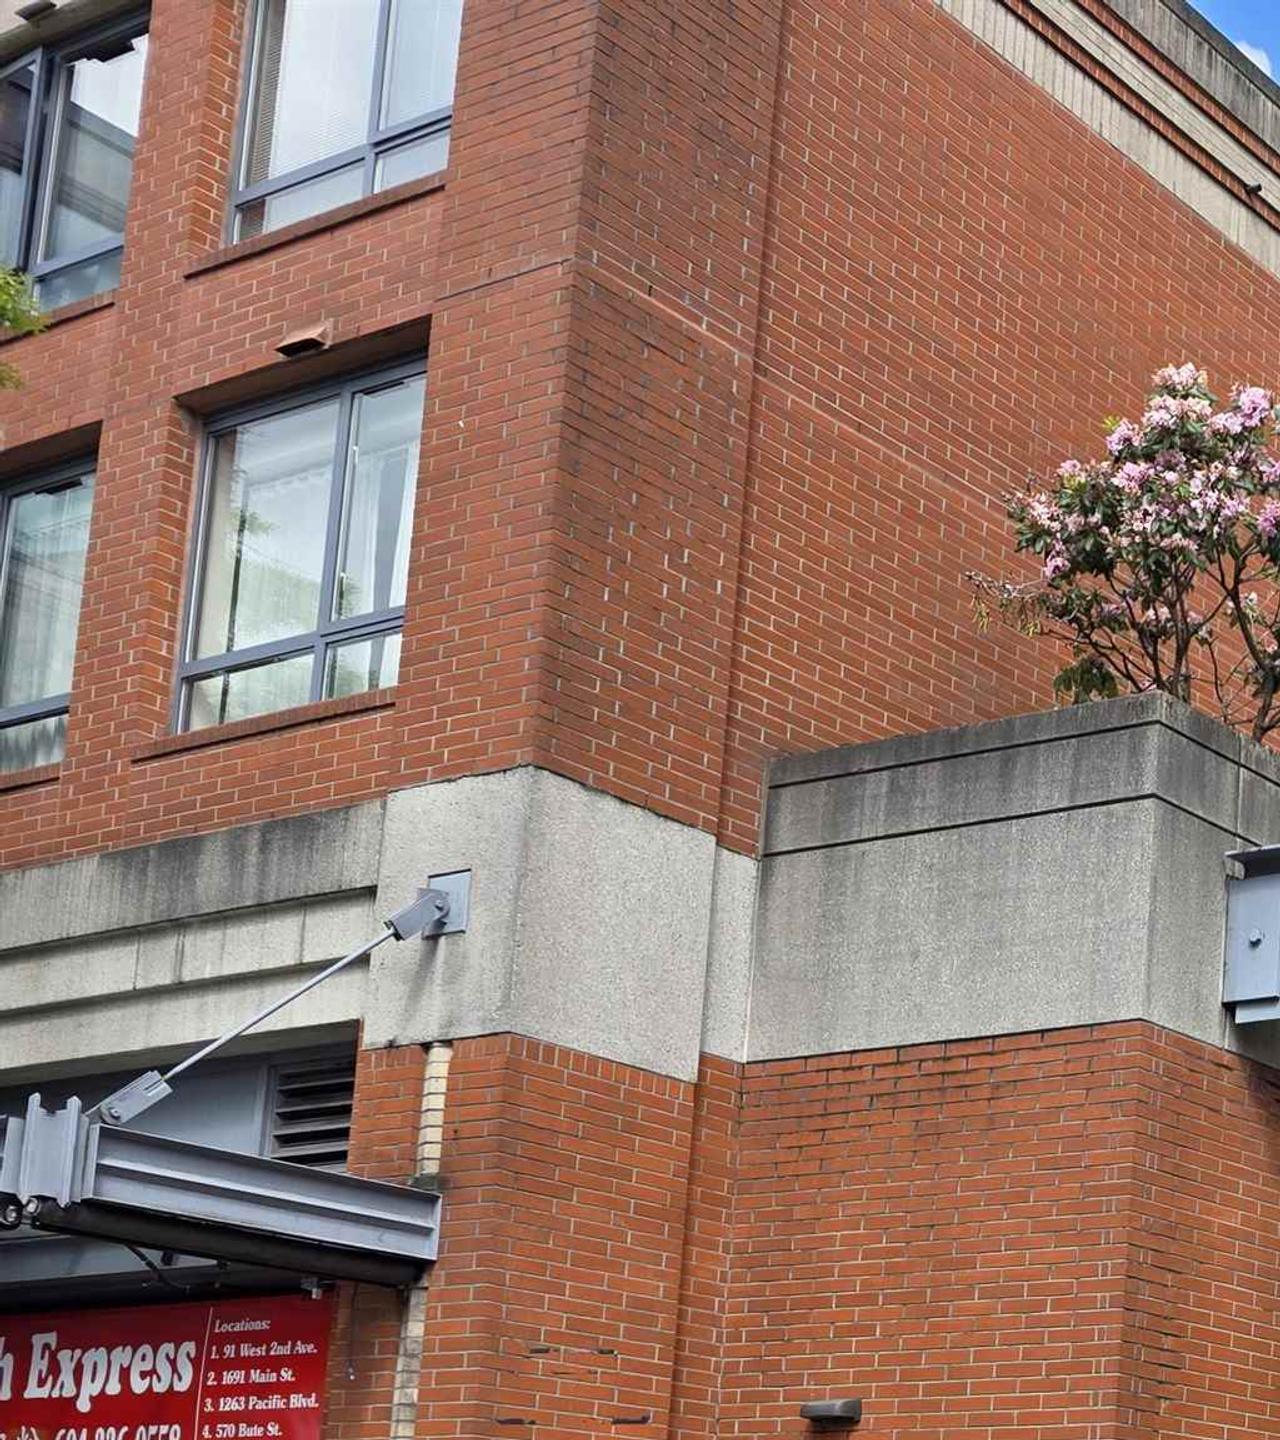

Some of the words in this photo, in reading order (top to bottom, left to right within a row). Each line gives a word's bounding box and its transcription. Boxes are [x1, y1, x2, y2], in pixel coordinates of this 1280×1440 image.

[214, 1318, 271, 1333] Locations:
[210, 1345, 219, 1359] 1.
[223, 1344, 236, 1358] 91
[240, 1343, 266, 1357] West
[270, 1341, 291, 1355] 2nd
[293, 1340, 318, 1354] Ave.
[23, 1331, 196, 1413] Express
[206, 1371, 217, 1386] 2.
[222, 1370, 245, 1385] 1691
[249, 1369, 277, 1384] Main
[280, 1367, 296, 1382] St.
[204, 1398, 214, 1412] 3.
[219, 1397, 245, 1411] 1263
[248, 1395, 287, 1410] Pacific
[289, 1393, 319, 1408] Blvd.
[202, 1424, 212, 1438] 4.
[215, 1424, 235, 1438] 570
[239, 1423, 264, 1437] Bute
[266, 1422, 282, 1436] St.
